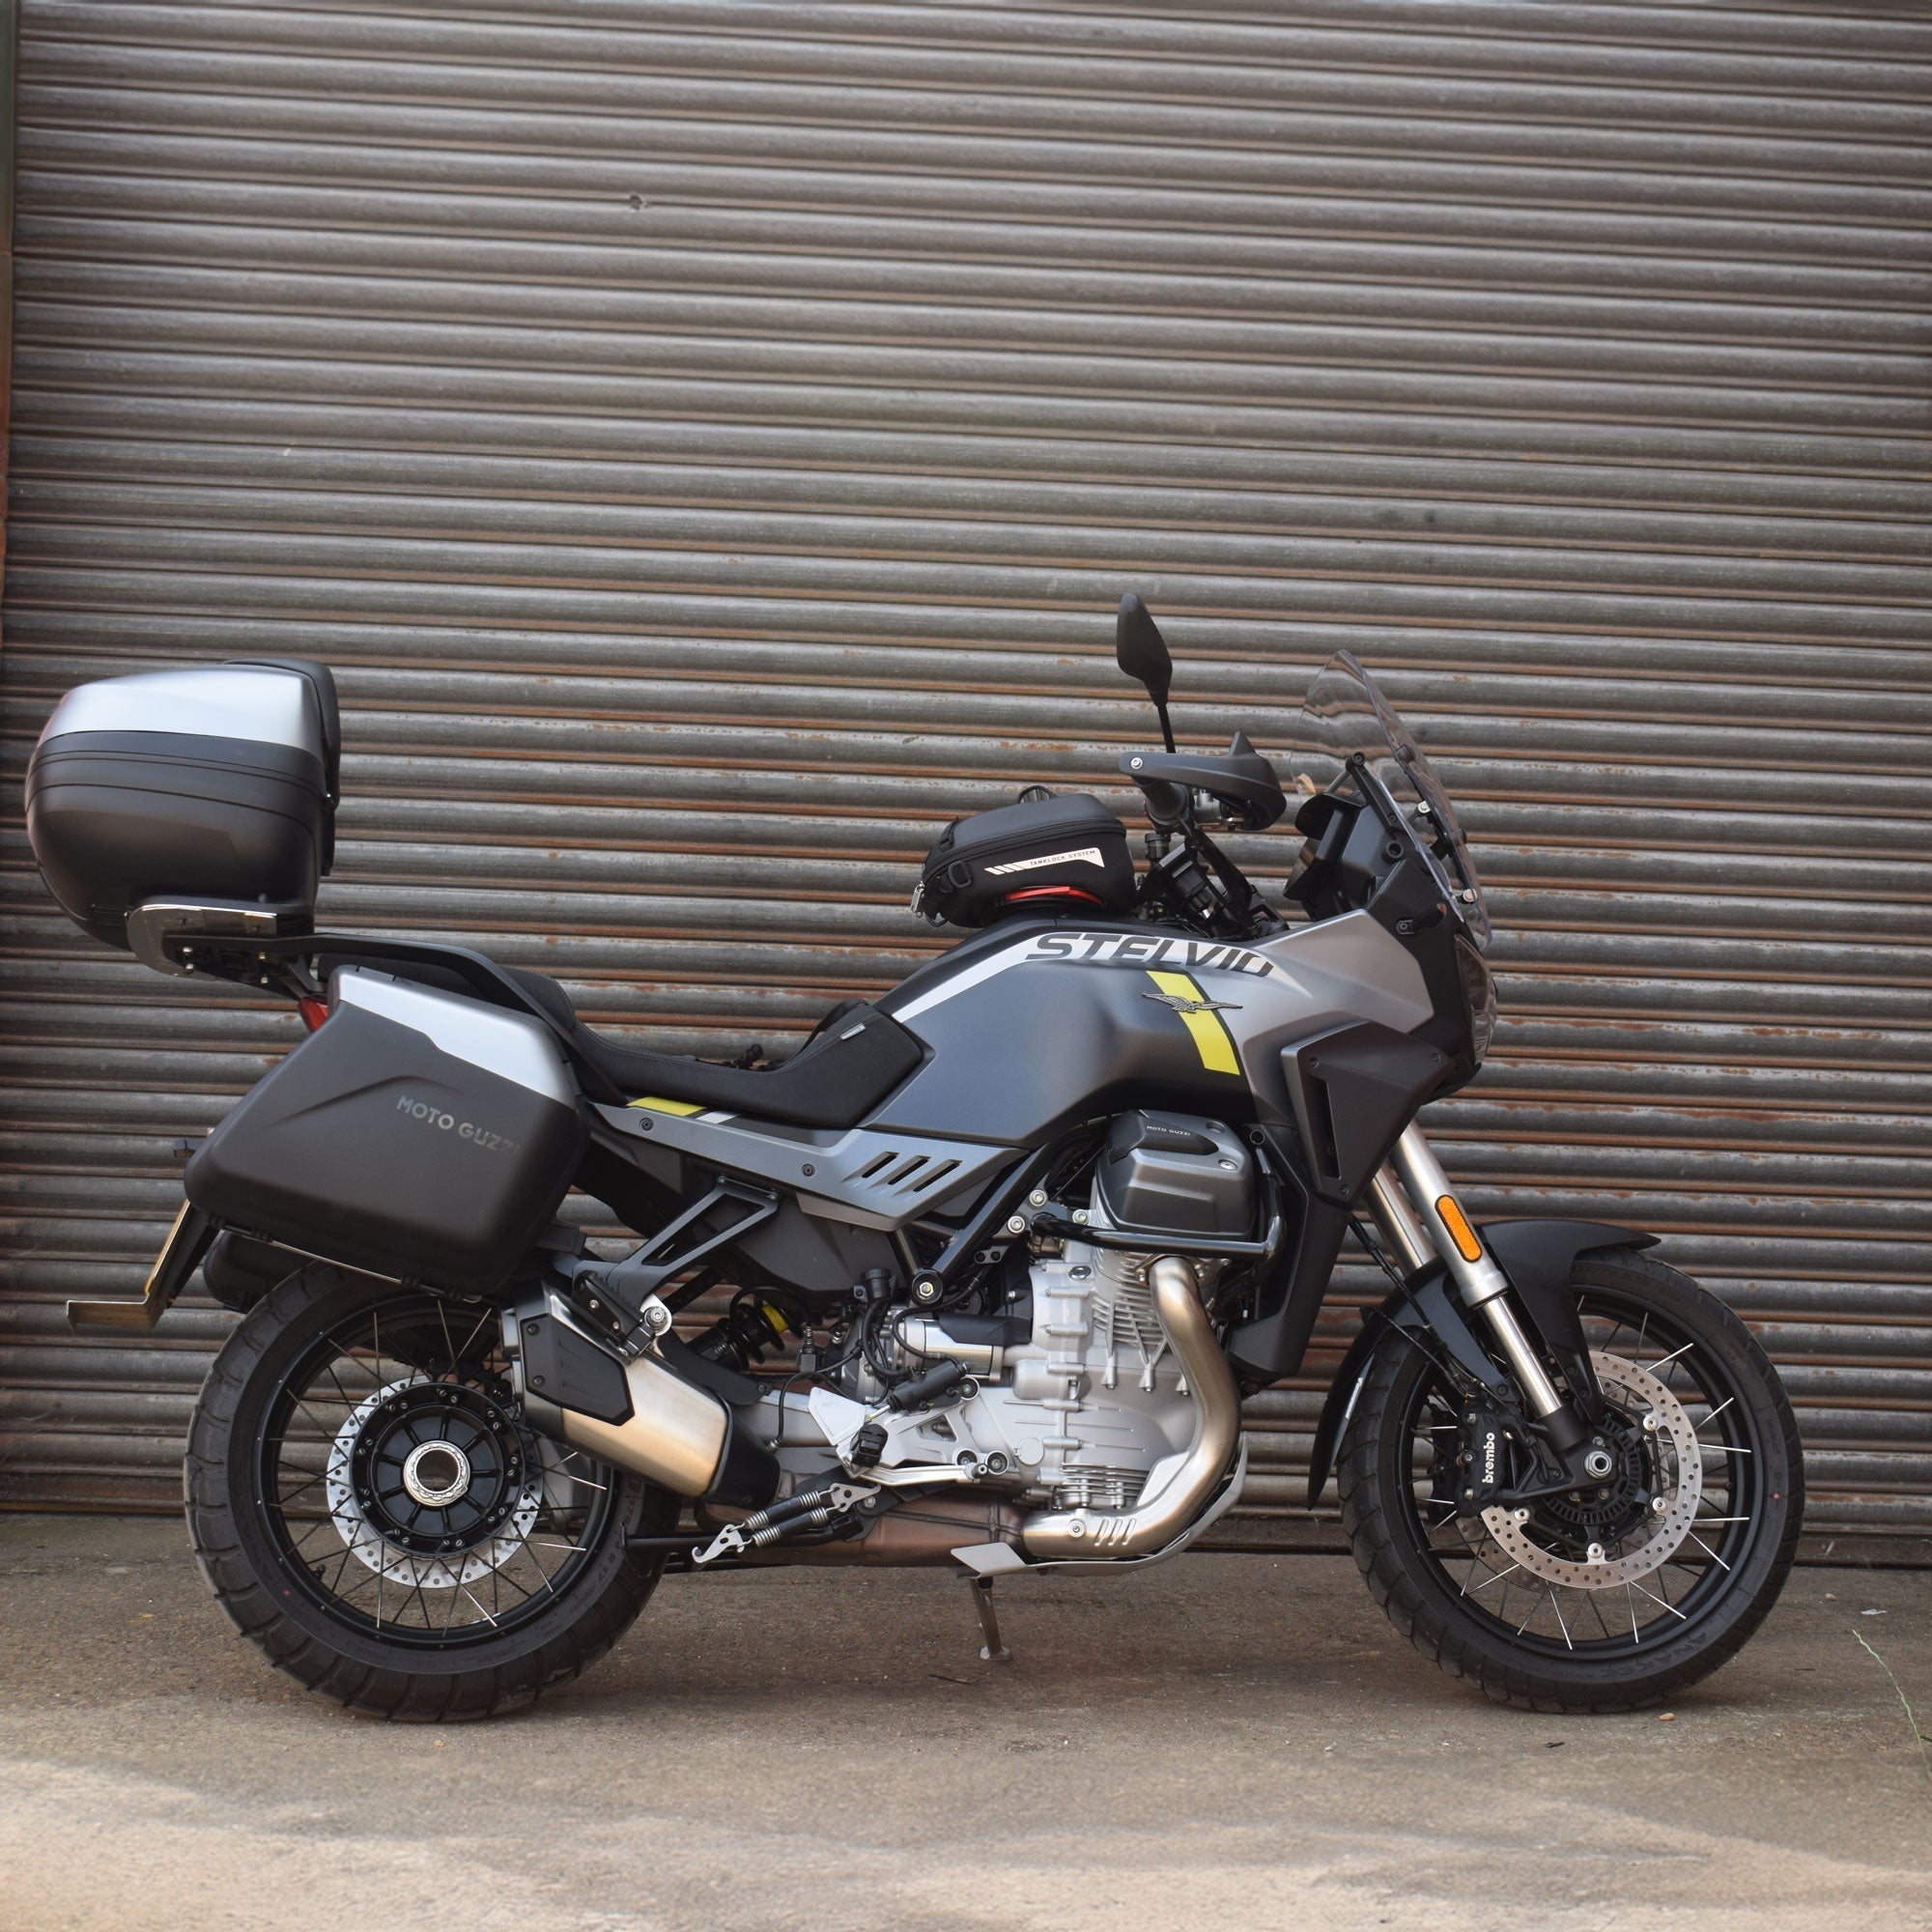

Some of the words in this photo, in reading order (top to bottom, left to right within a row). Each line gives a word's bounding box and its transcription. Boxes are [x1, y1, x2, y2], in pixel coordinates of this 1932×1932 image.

[1029, 855, 1066, 867] TANKLOCK
[1068, 849, 1095, 859] SYSTEM
[1024, 932, 1274, 978] STELVIO
[395, 1094, 455, 1130] MOTO
[1481, 1432, 1495, 1484] brembo
